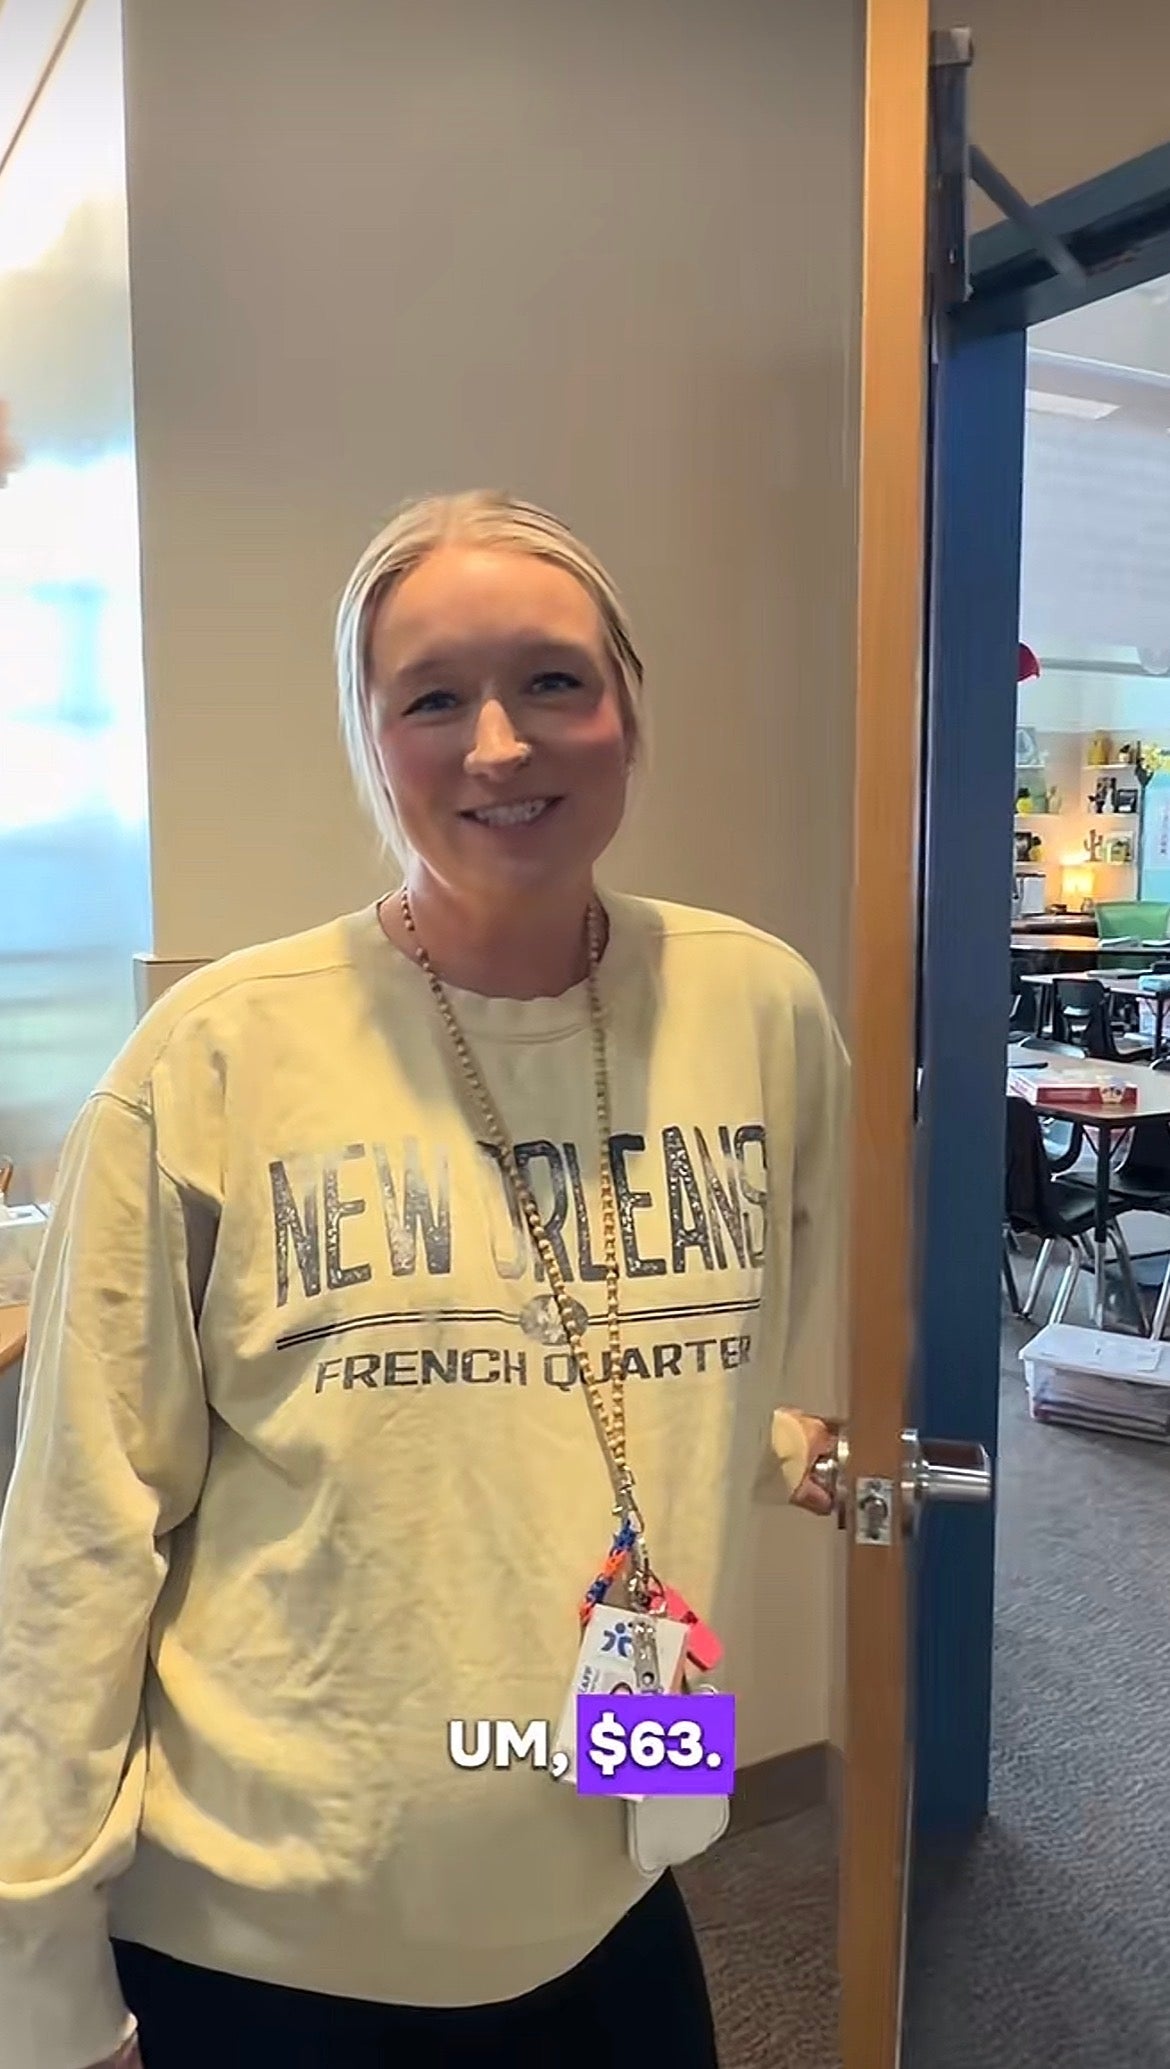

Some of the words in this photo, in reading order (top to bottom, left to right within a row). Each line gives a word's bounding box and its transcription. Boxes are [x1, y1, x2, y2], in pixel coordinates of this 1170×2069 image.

[268, 1136, 452, 1307] NEW
[478, 1124, 768, 1284] ORLEANS
[314, 1347, 527, 1395] FRENCH
[543, 1334, 752, 1391] QUARTER
